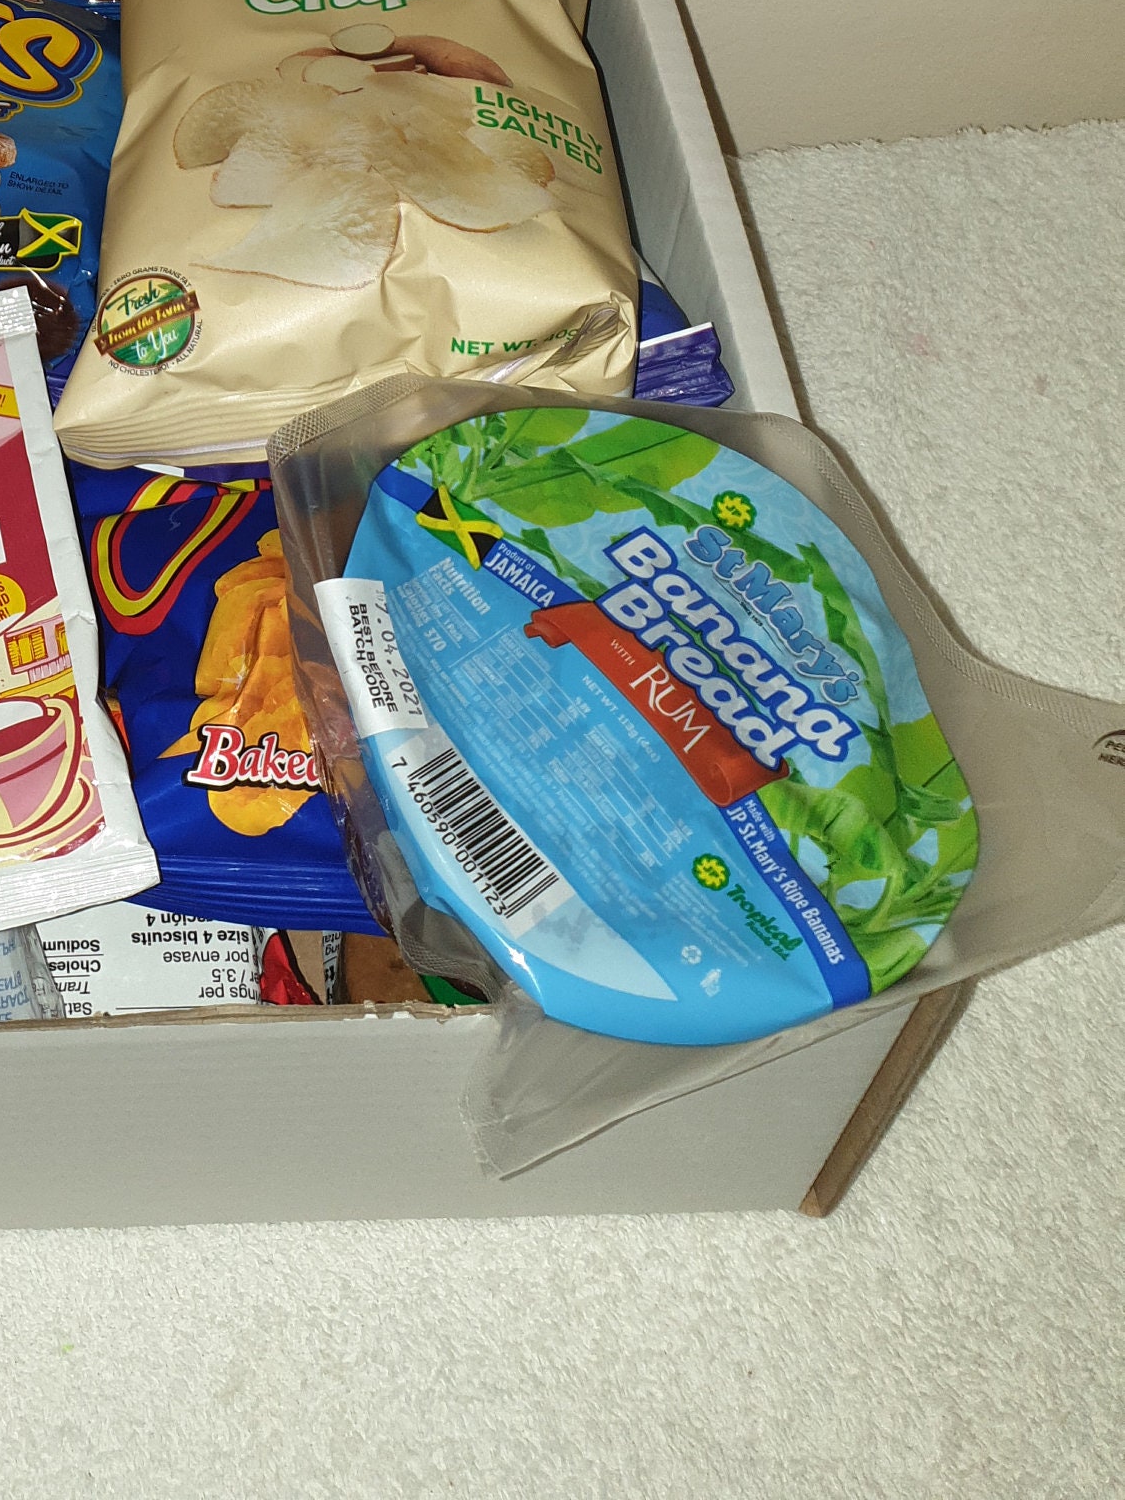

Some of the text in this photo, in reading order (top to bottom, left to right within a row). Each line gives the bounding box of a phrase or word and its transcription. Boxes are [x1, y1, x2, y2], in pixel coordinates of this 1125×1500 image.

[475, 86, 603, 156] LIGHTLY
[477, 109, 602, 174] SALTED
[7, 180, 34, 191] SHOW
[159, 266, 181, 279] TRANS
[180, 276, 192, 287] FAT
[105, 280, 160, 316] Fresh
[137, 316, 153, 331] the
[147, 327, 179, 360] You
[176, 319, 203, 365] ALL NATURAL
[451, 337, 494, 356] NET
[108, 360, 119, 369] NO
[498, 543, 535, 572] Product of
[428, 565, 456, 596] Facts
[438, 556, 491, 616] Nutrition
[484, 551, 556, 608] JAMAICA
[608, 530, 856, 759] Banana
[734, 561, 864, 705] Mary's
[349, 604, 386, 710] BATCH CODE
[359, 602, 398, 713] BEST BEFORE
[375, 592, 423, 715] 7.04.2021
[610, 638, 636, 667] WITH
[582, 675, 602, 697] NET
[599, 581, 798, 769] Bread
[629, 662, 712, 754] RUM
[390, 757, 505, 917] 7 460590 001123
[744, 799, 776, 842] Made with
[727, 806, 747, 823] JP
[780, 878, 809, 910] Ripe
[801, 906, 845, 965] Bananas
[727, 884, 803, 951] Tropical
[42, 938, 100, 952] Sodium
[131, 930, 249, 946] size 4 biscuits
[163, 949, 249, 963] por envase
[56, 981, 90, 994] Tran
[199, 986, 224, 999] per
[212, 968, 237, 983] 3.5
